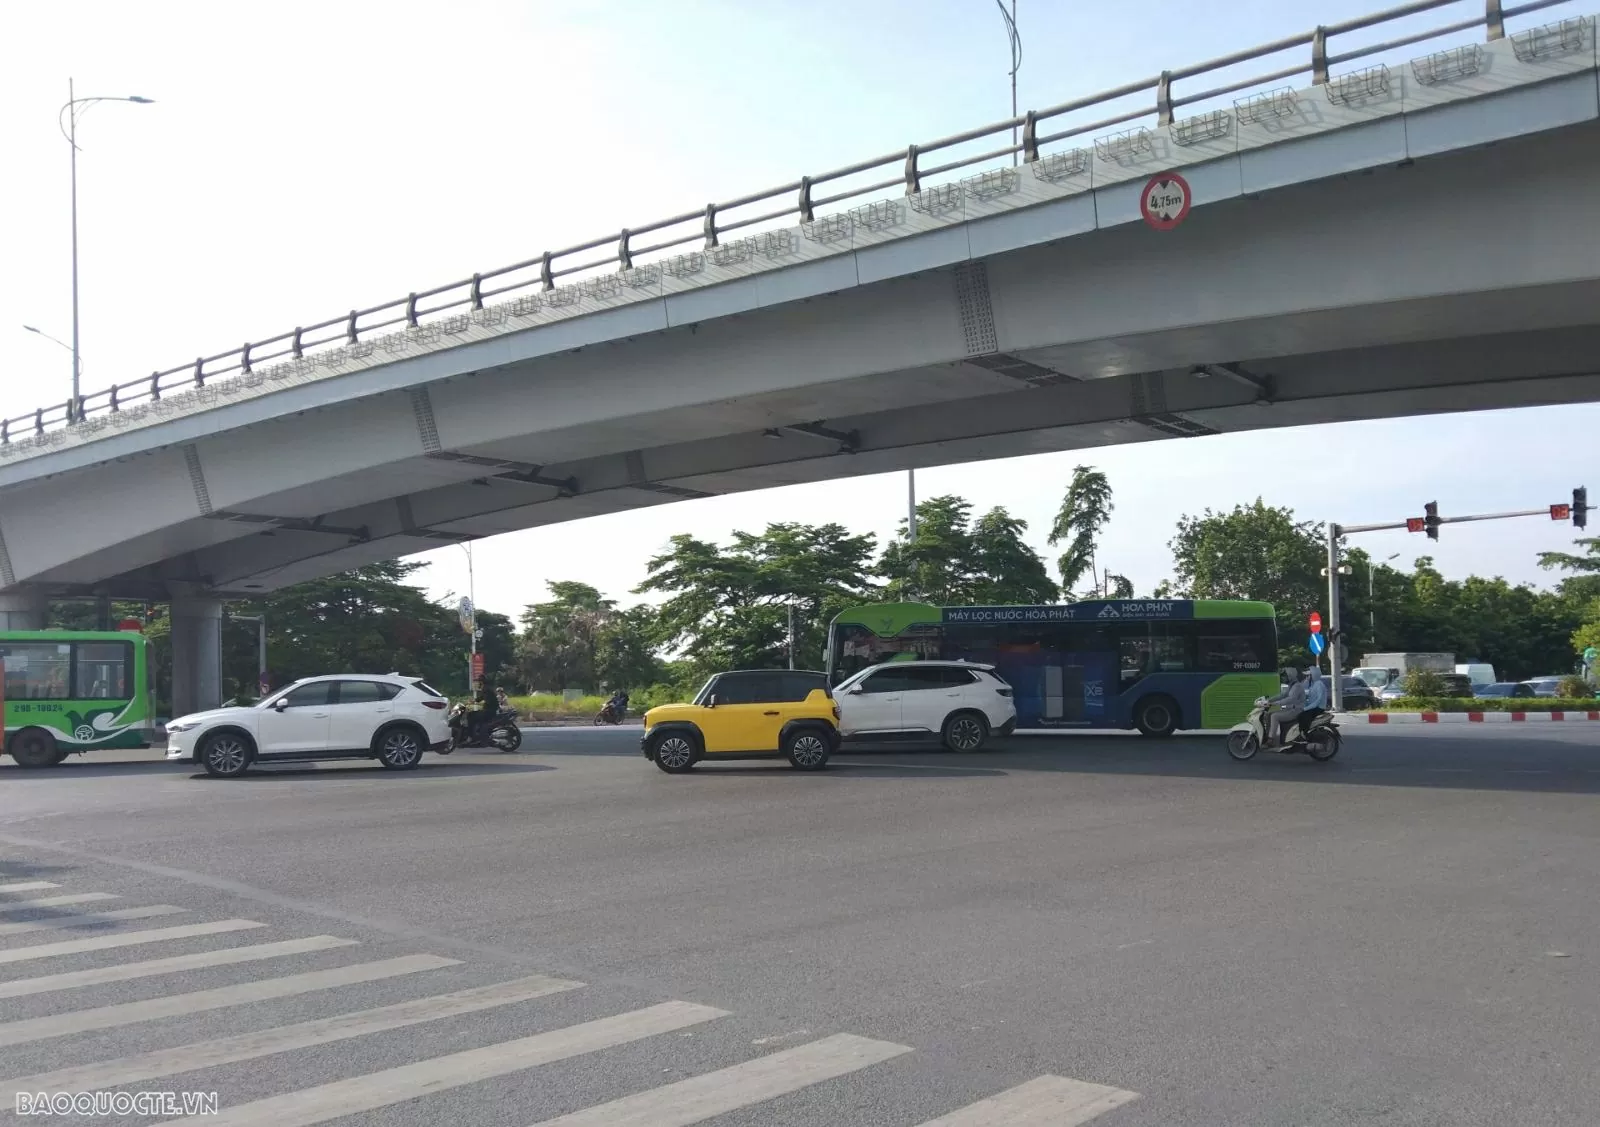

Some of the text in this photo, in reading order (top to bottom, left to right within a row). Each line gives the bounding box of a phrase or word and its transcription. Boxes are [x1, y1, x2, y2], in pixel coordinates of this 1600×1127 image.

[1150, 195, 1182, 209] 4.75m
[948, 609, 969, 620] MÁY
[972, 611, 992, 621] LỌC
[1025, 609, 1047, 619] HÒA
[1049, 608, 1076, 619] PHÁT
